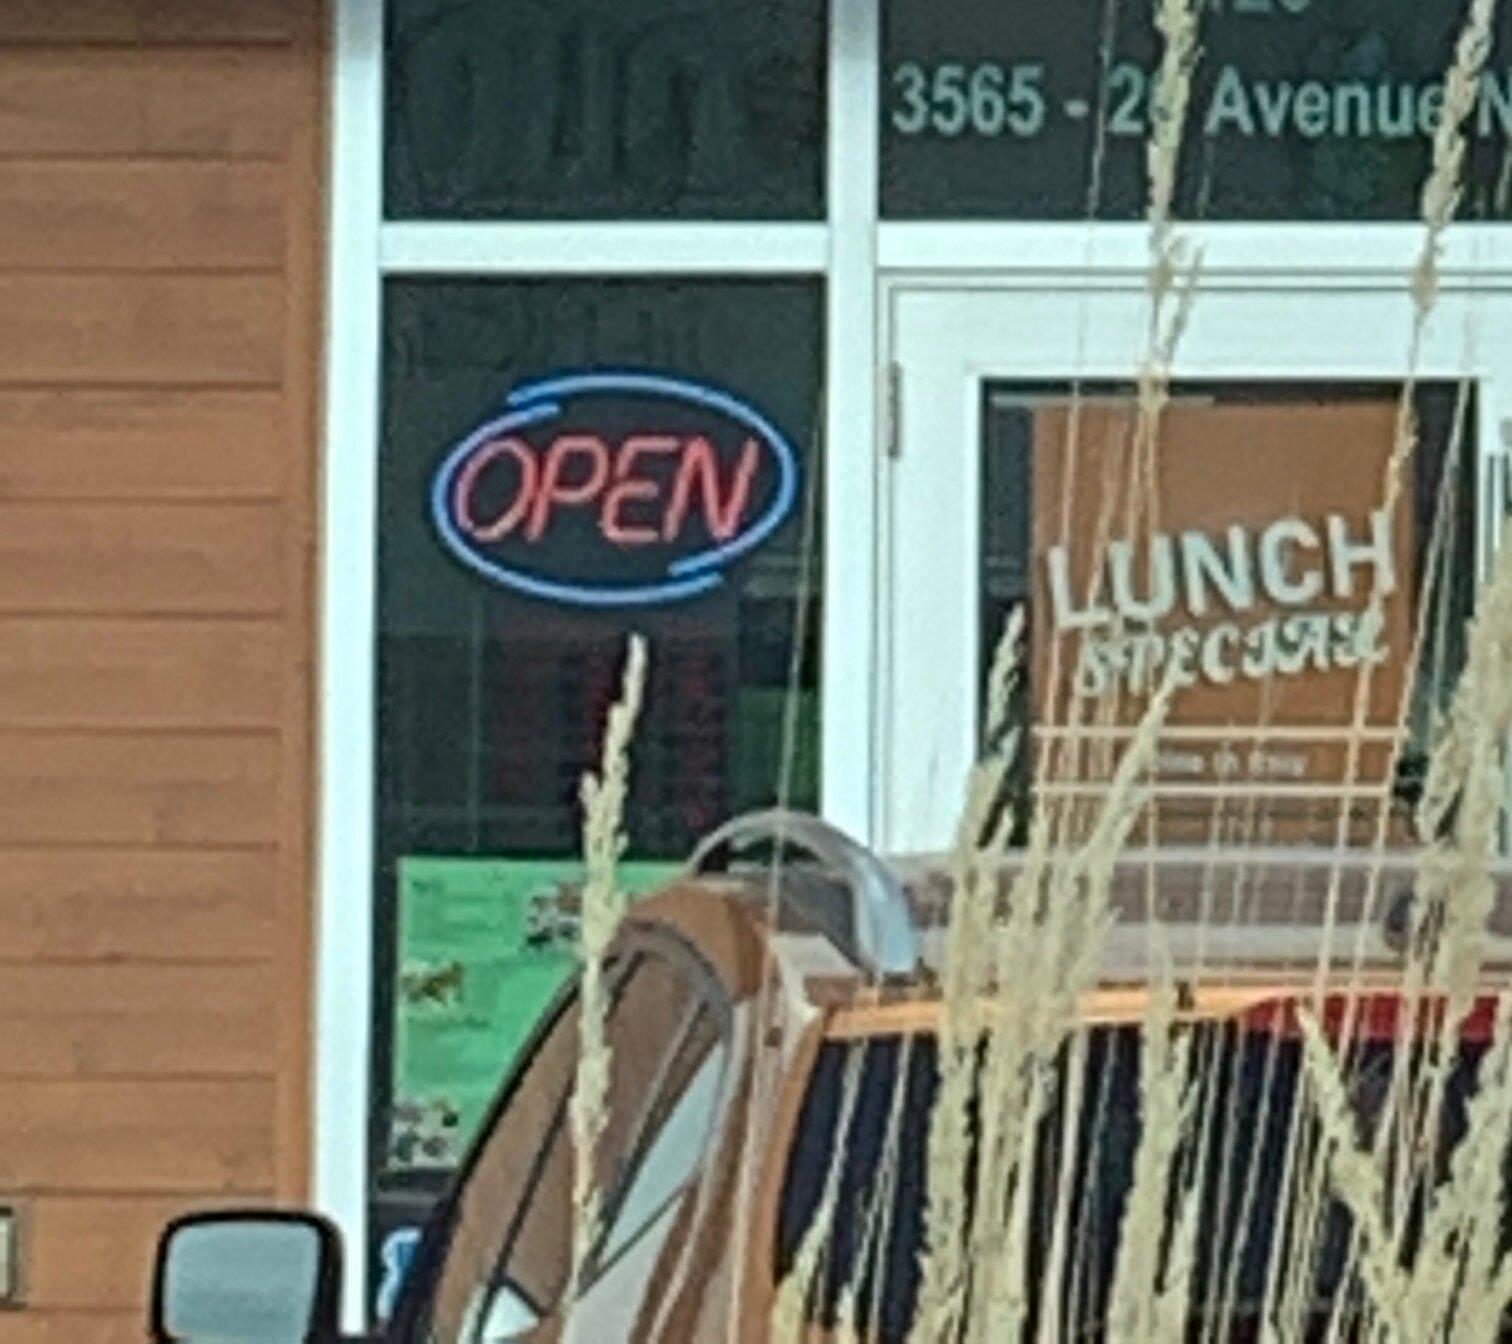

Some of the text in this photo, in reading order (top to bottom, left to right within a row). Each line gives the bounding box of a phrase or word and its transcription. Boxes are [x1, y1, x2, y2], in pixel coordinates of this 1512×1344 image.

[892, 63, 1045, 137] 3565
[454, 435, 761, 544] OPEN
[1047, 510, 1396, 630] LUNCH
